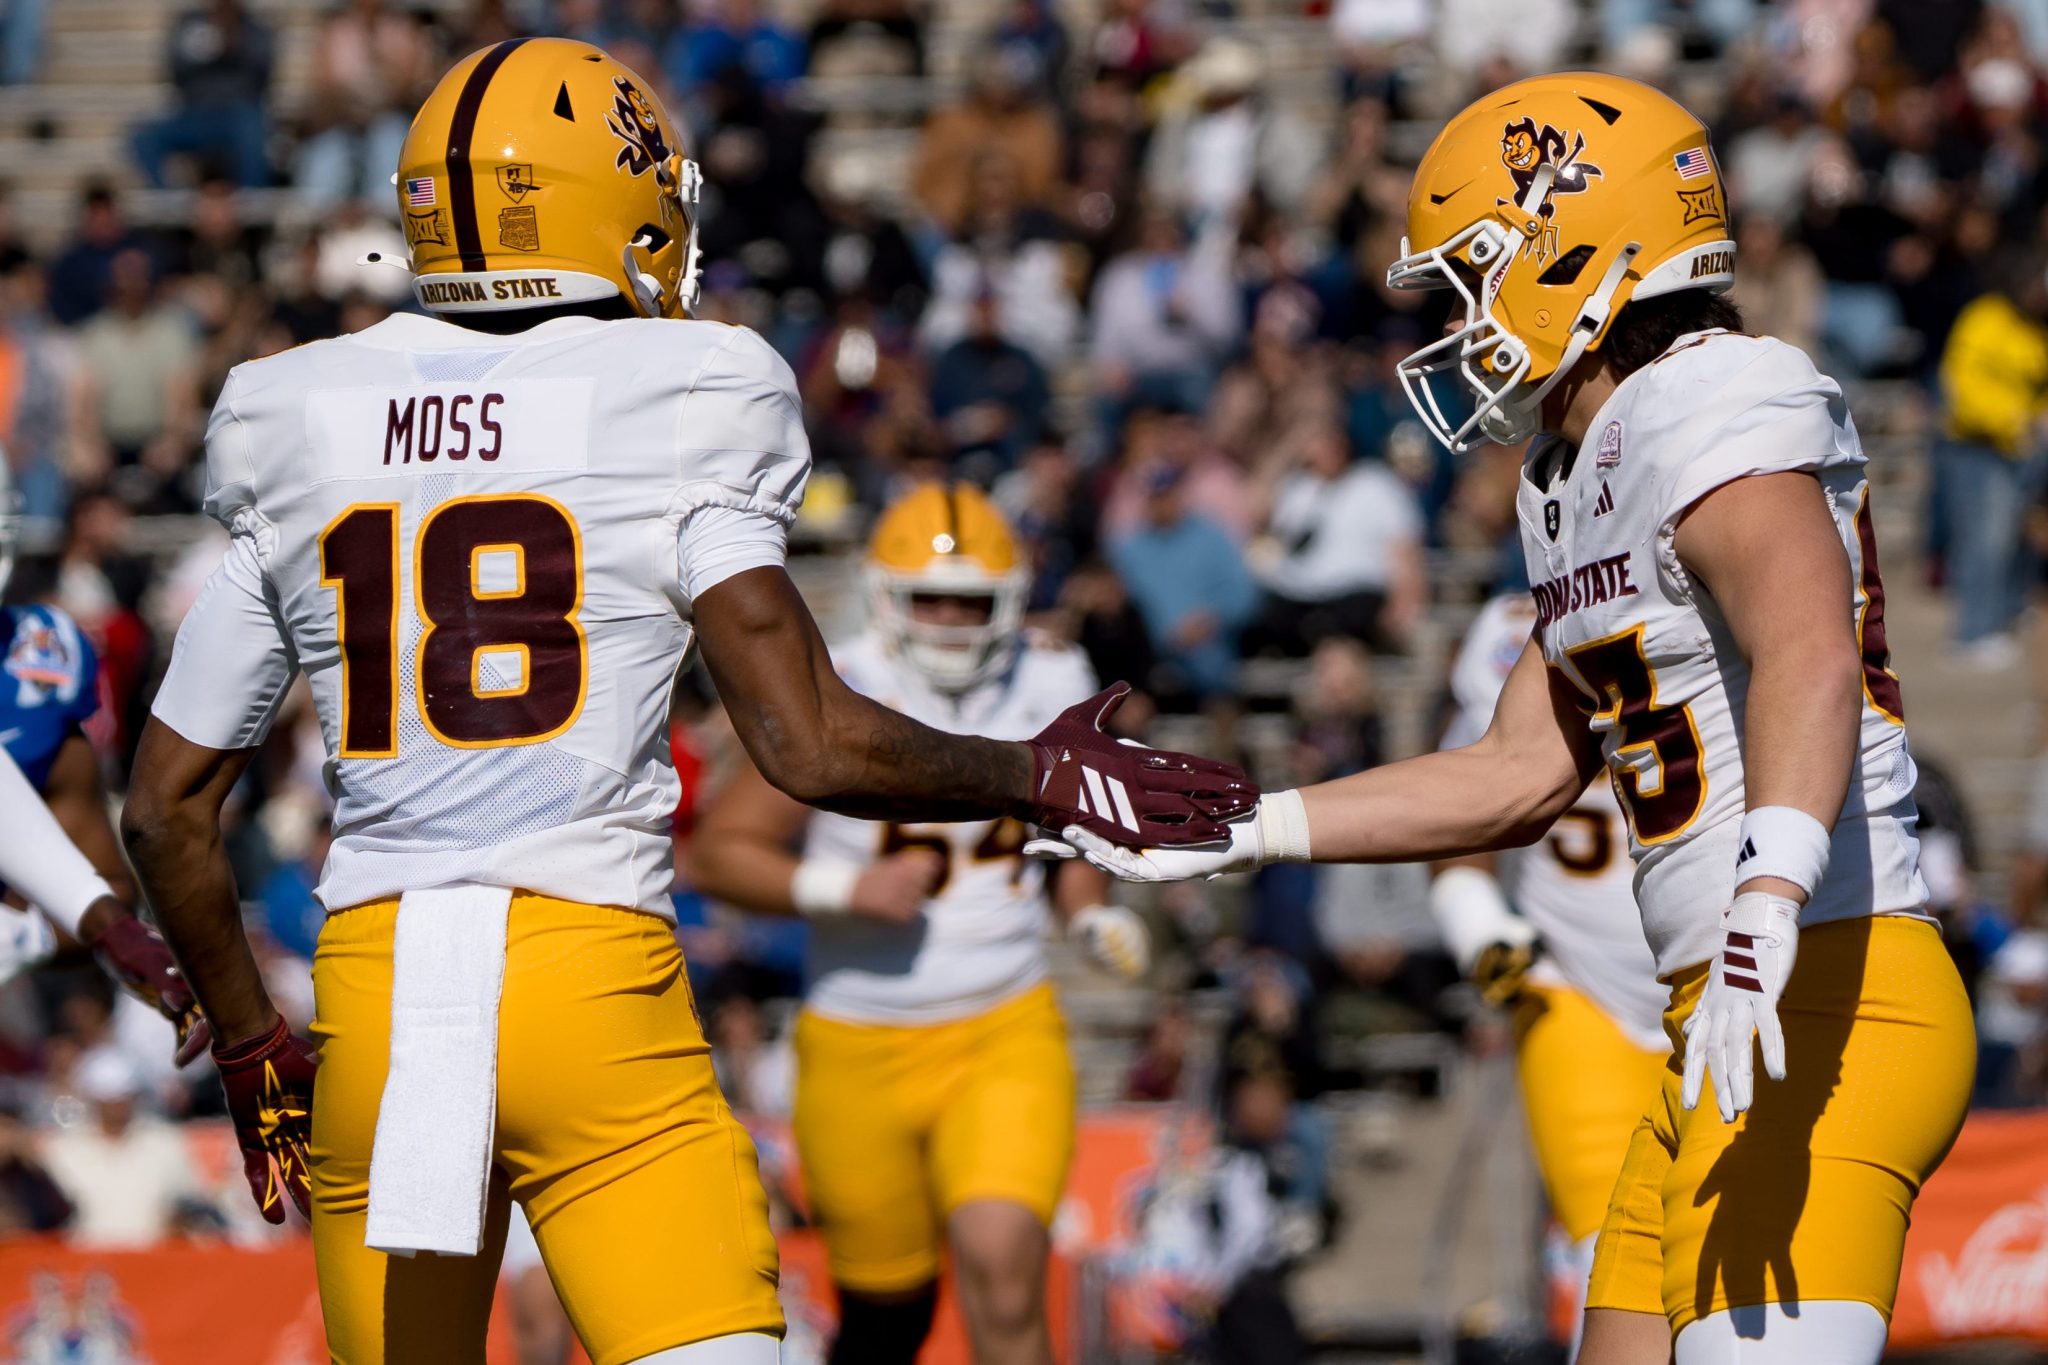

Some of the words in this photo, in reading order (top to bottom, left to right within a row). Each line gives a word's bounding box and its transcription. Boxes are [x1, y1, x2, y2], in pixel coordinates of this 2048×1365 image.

[420, 281, 488, 304] ARIZONA
[492, 278, 562, 300] STATE
[1690, 251, 1736, 280] ARIZON
[383, 393, 504, 465] MOSS
[1570, 550, 1640, 613] STATE
[317, 492, 589, 759] 18
